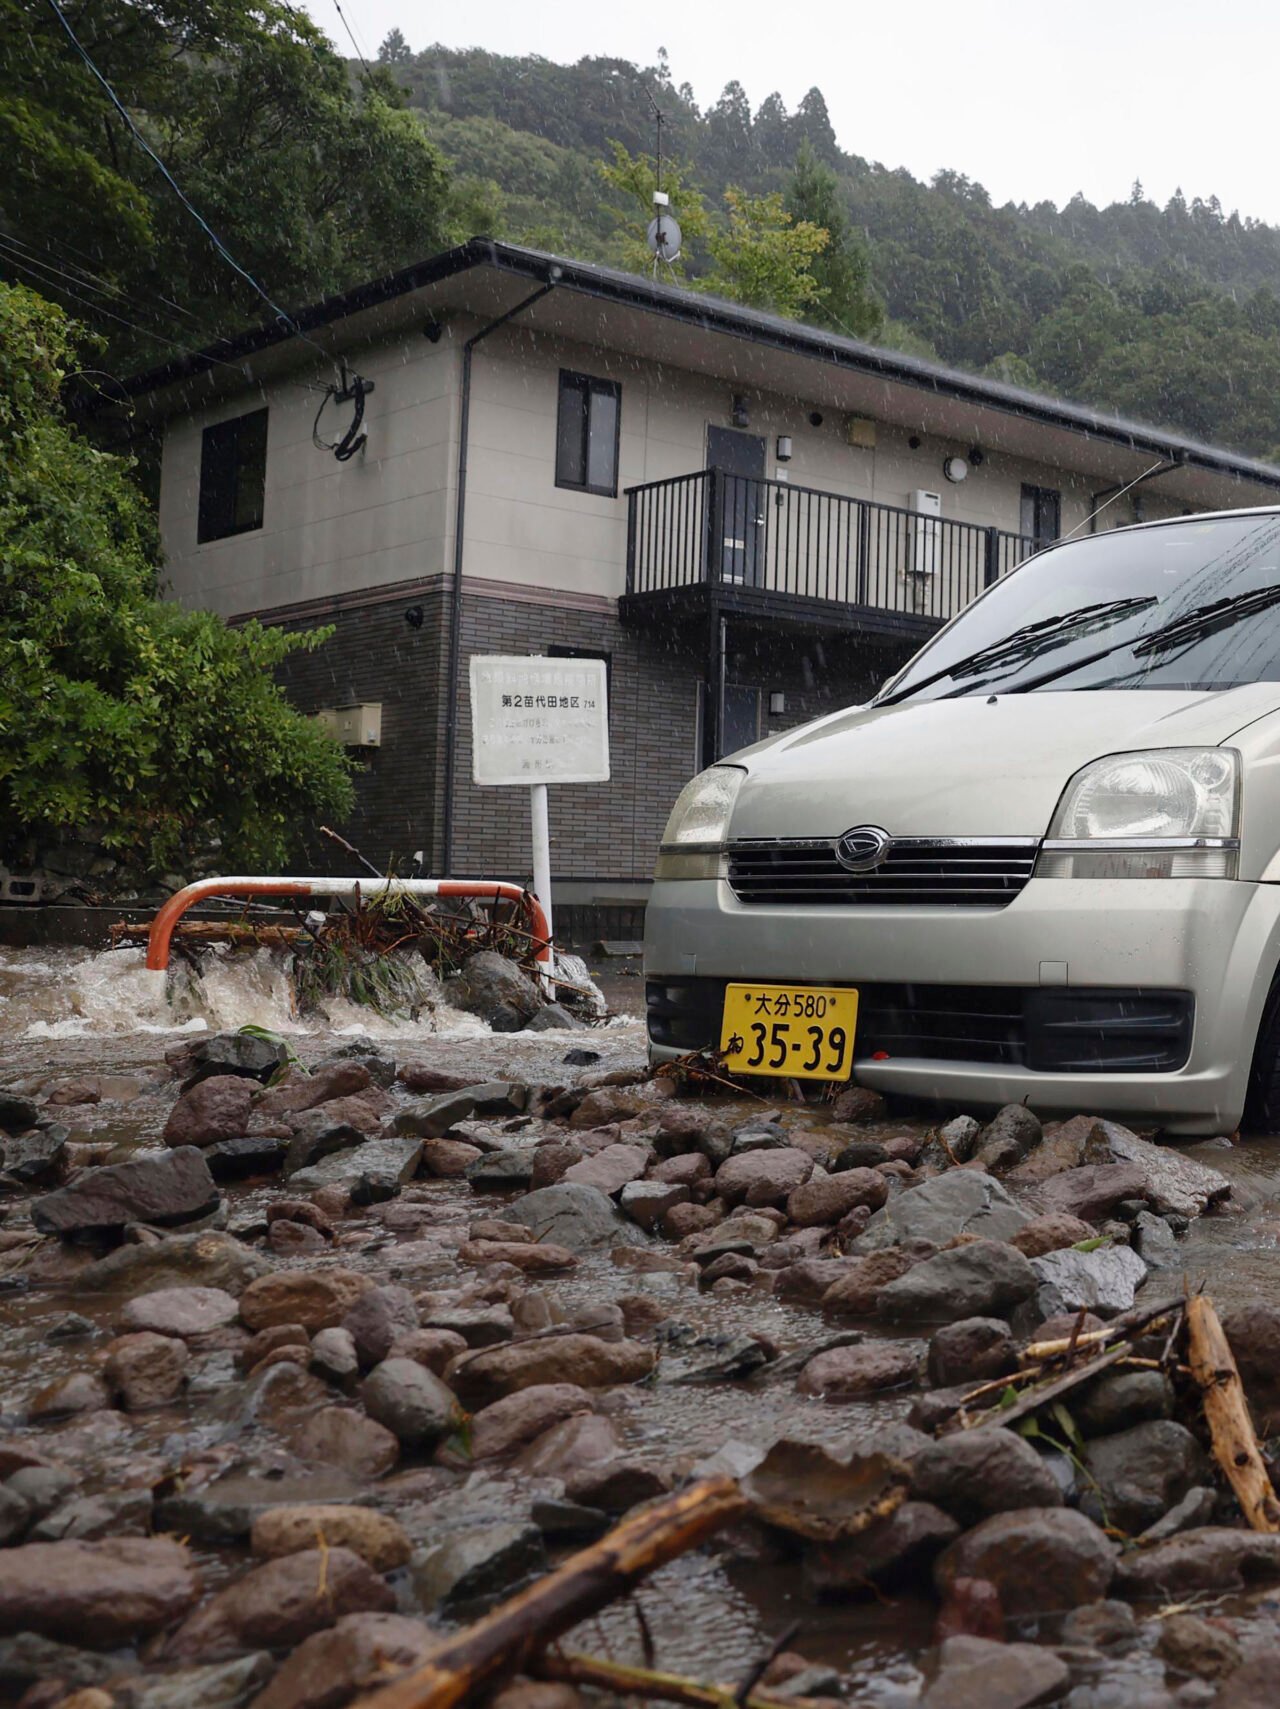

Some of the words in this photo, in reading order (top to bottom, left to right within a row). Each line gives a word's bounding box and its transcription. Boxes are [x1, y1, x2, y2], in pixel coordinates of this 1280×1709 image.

[501, 694, 580, 709] 第2苗代田地区
[747, 1022, 846, 1073] 35-39
